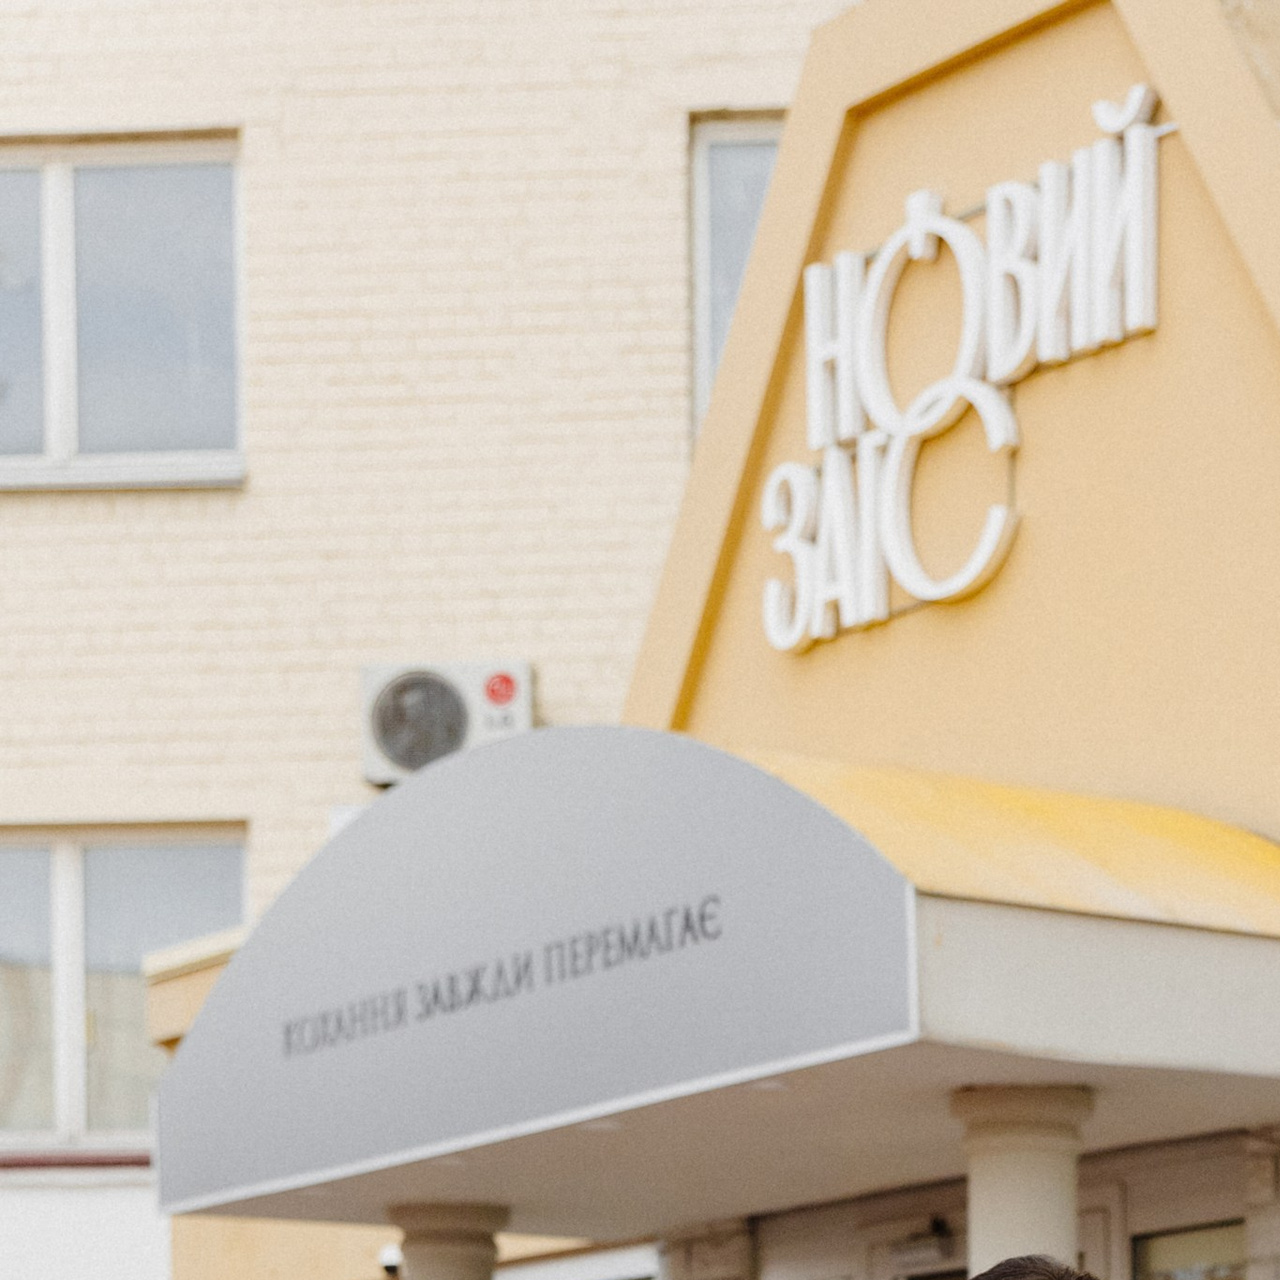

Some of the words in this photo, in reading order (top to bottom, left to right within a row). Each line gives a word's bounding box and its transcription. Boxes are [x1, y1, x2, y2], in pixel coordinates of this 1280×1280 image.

[804, 82, 1161, 450] НОВИЙ
[760, 376, 1020, 650] ЗАГС
[415, 950, 535, 1022] ЗАВЖДИ
[543, 894, 723, 984] ПЕРЕМАГАЄ
